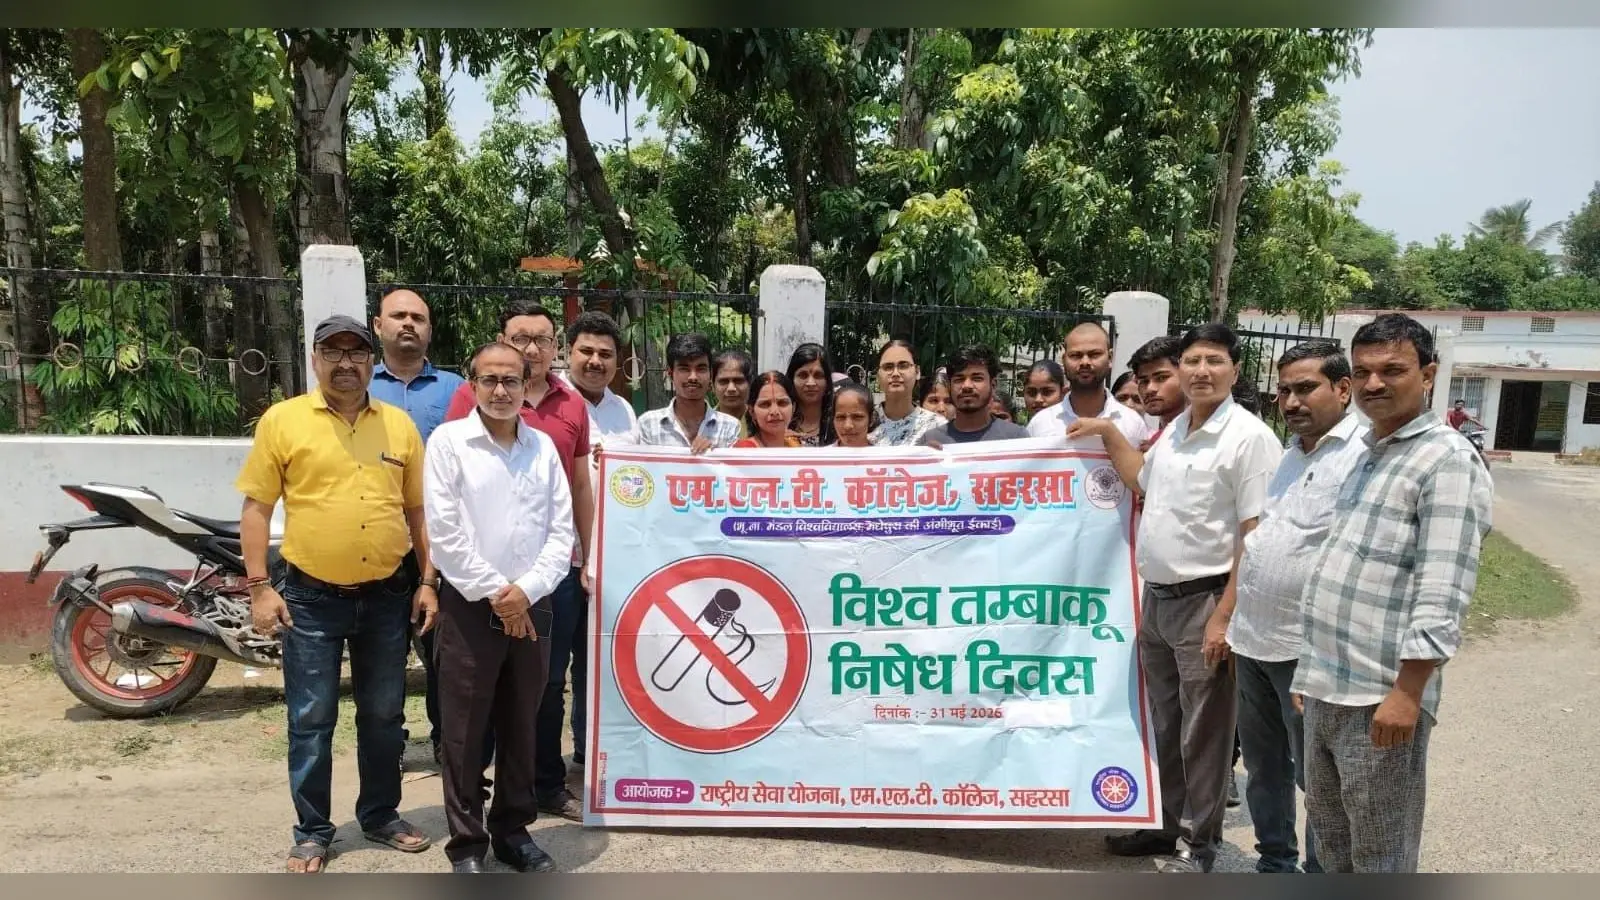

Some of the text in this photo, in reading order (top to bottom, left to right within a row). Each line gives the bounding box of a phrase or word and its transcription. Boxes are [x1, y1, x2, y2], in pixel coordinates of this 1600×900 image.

[665, 468, 835, 513] एम.एल.टी.
[843, 467, 960, 512] कॉलेज,
[968, 470, 1077, 510] सहरसा
[766, 519, 793, 532] मंडल
[828, 573, 1126, 642] विश्व तम्बाकू
[828, 639, 1098, 695] निषेध दिवस
[874, 704, 911, 720] दिनांक
[930, 707, 945, 719] 31
[950, 704, 966, 721] मई
[621, 781, 674, 799] आयोजक
[700, 779, 749, 807] राष्ट्रीय
[752, 780, 786, 803] सेवा
[787, 781, 846, 807] योजना,
[850, 782, 938, 807] एम.एल.टी.
[942, 783, 1005, 808] कॉलेज,
[1009, 788, 1070, 808] सहरसा
